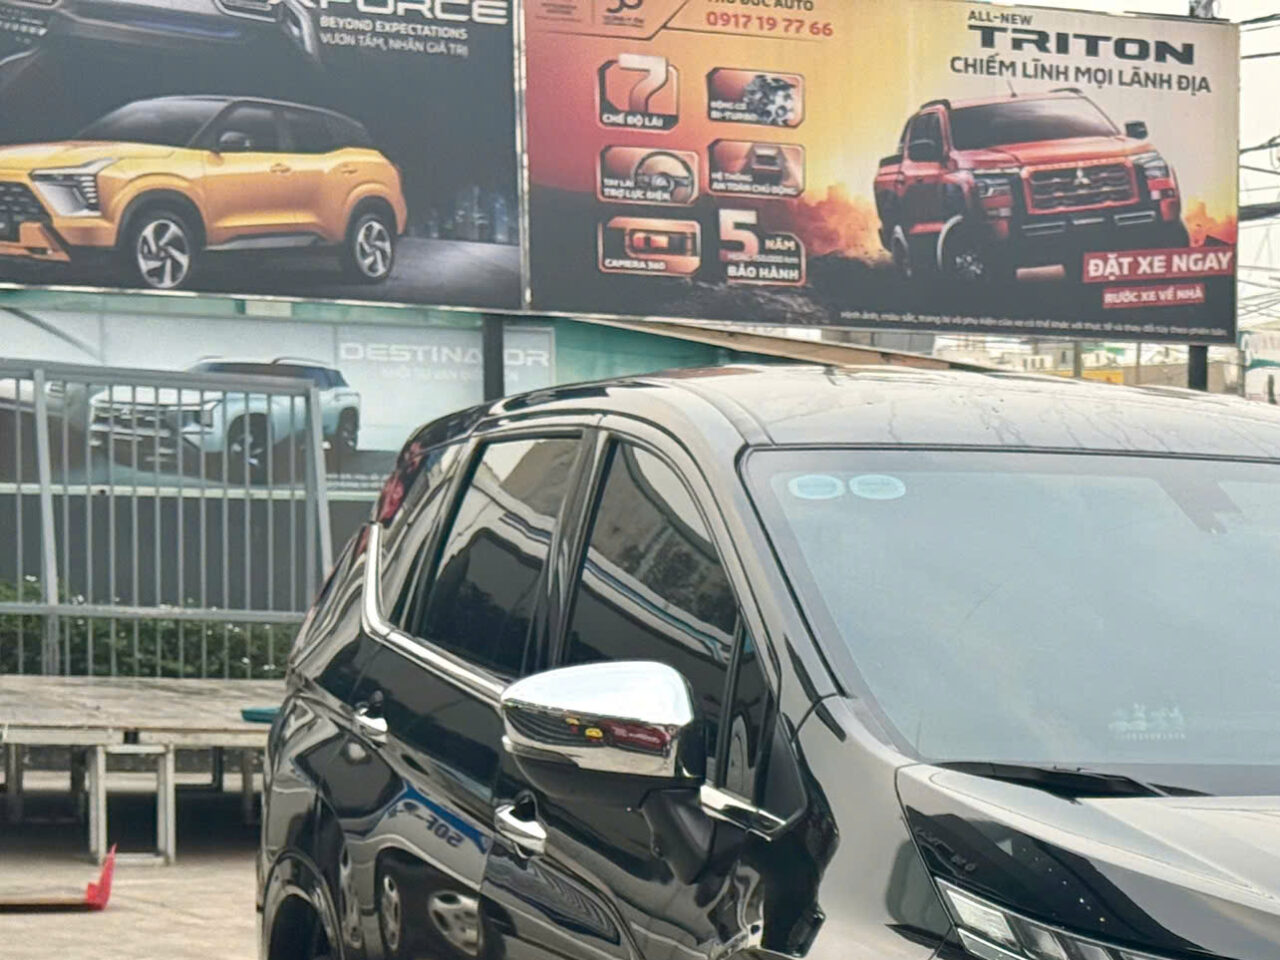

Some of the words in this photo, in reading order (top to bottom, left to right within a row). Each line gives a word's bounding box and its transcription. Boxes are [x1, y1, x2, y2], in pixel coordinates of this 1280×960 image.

[320, 16, 373, 31] BEYOND
[375, 20, 468, 40] EXPECTATIONS
[706, 11, 752, 29] 0917
[756, 16, 777, 31] 19
[782, 18, 805, 34] 77
[809, 21, 834, 37] 66
[968, 10, 1033, 26] ALL-NEW
[968, 24, 1195, 65] TRITON
[619, 53, 668, 112] 7
[950, 53, 1016, 77] CHIẾM
[1022, 58, 1069, 82] LĨNH
[1074, 67, 1113, 89] MỌI
[1118, 66, 1172, 91] LÃNH
[1177, 75, 1212, 96] ĐỊA
[719, 209, 759, 261] 5
[765, 237, 796, 251] NĂM
[727, 263, 757, 278] BẢO
[759, 265, 799, 280] HÀNH
[1088, 253, 1134, 281] ĐẶT
[1137, 255, 1167, 275] XE
[1171, 251, 1233, 273] NGAY
[340, 343, 551, 367] DESTINAOR
